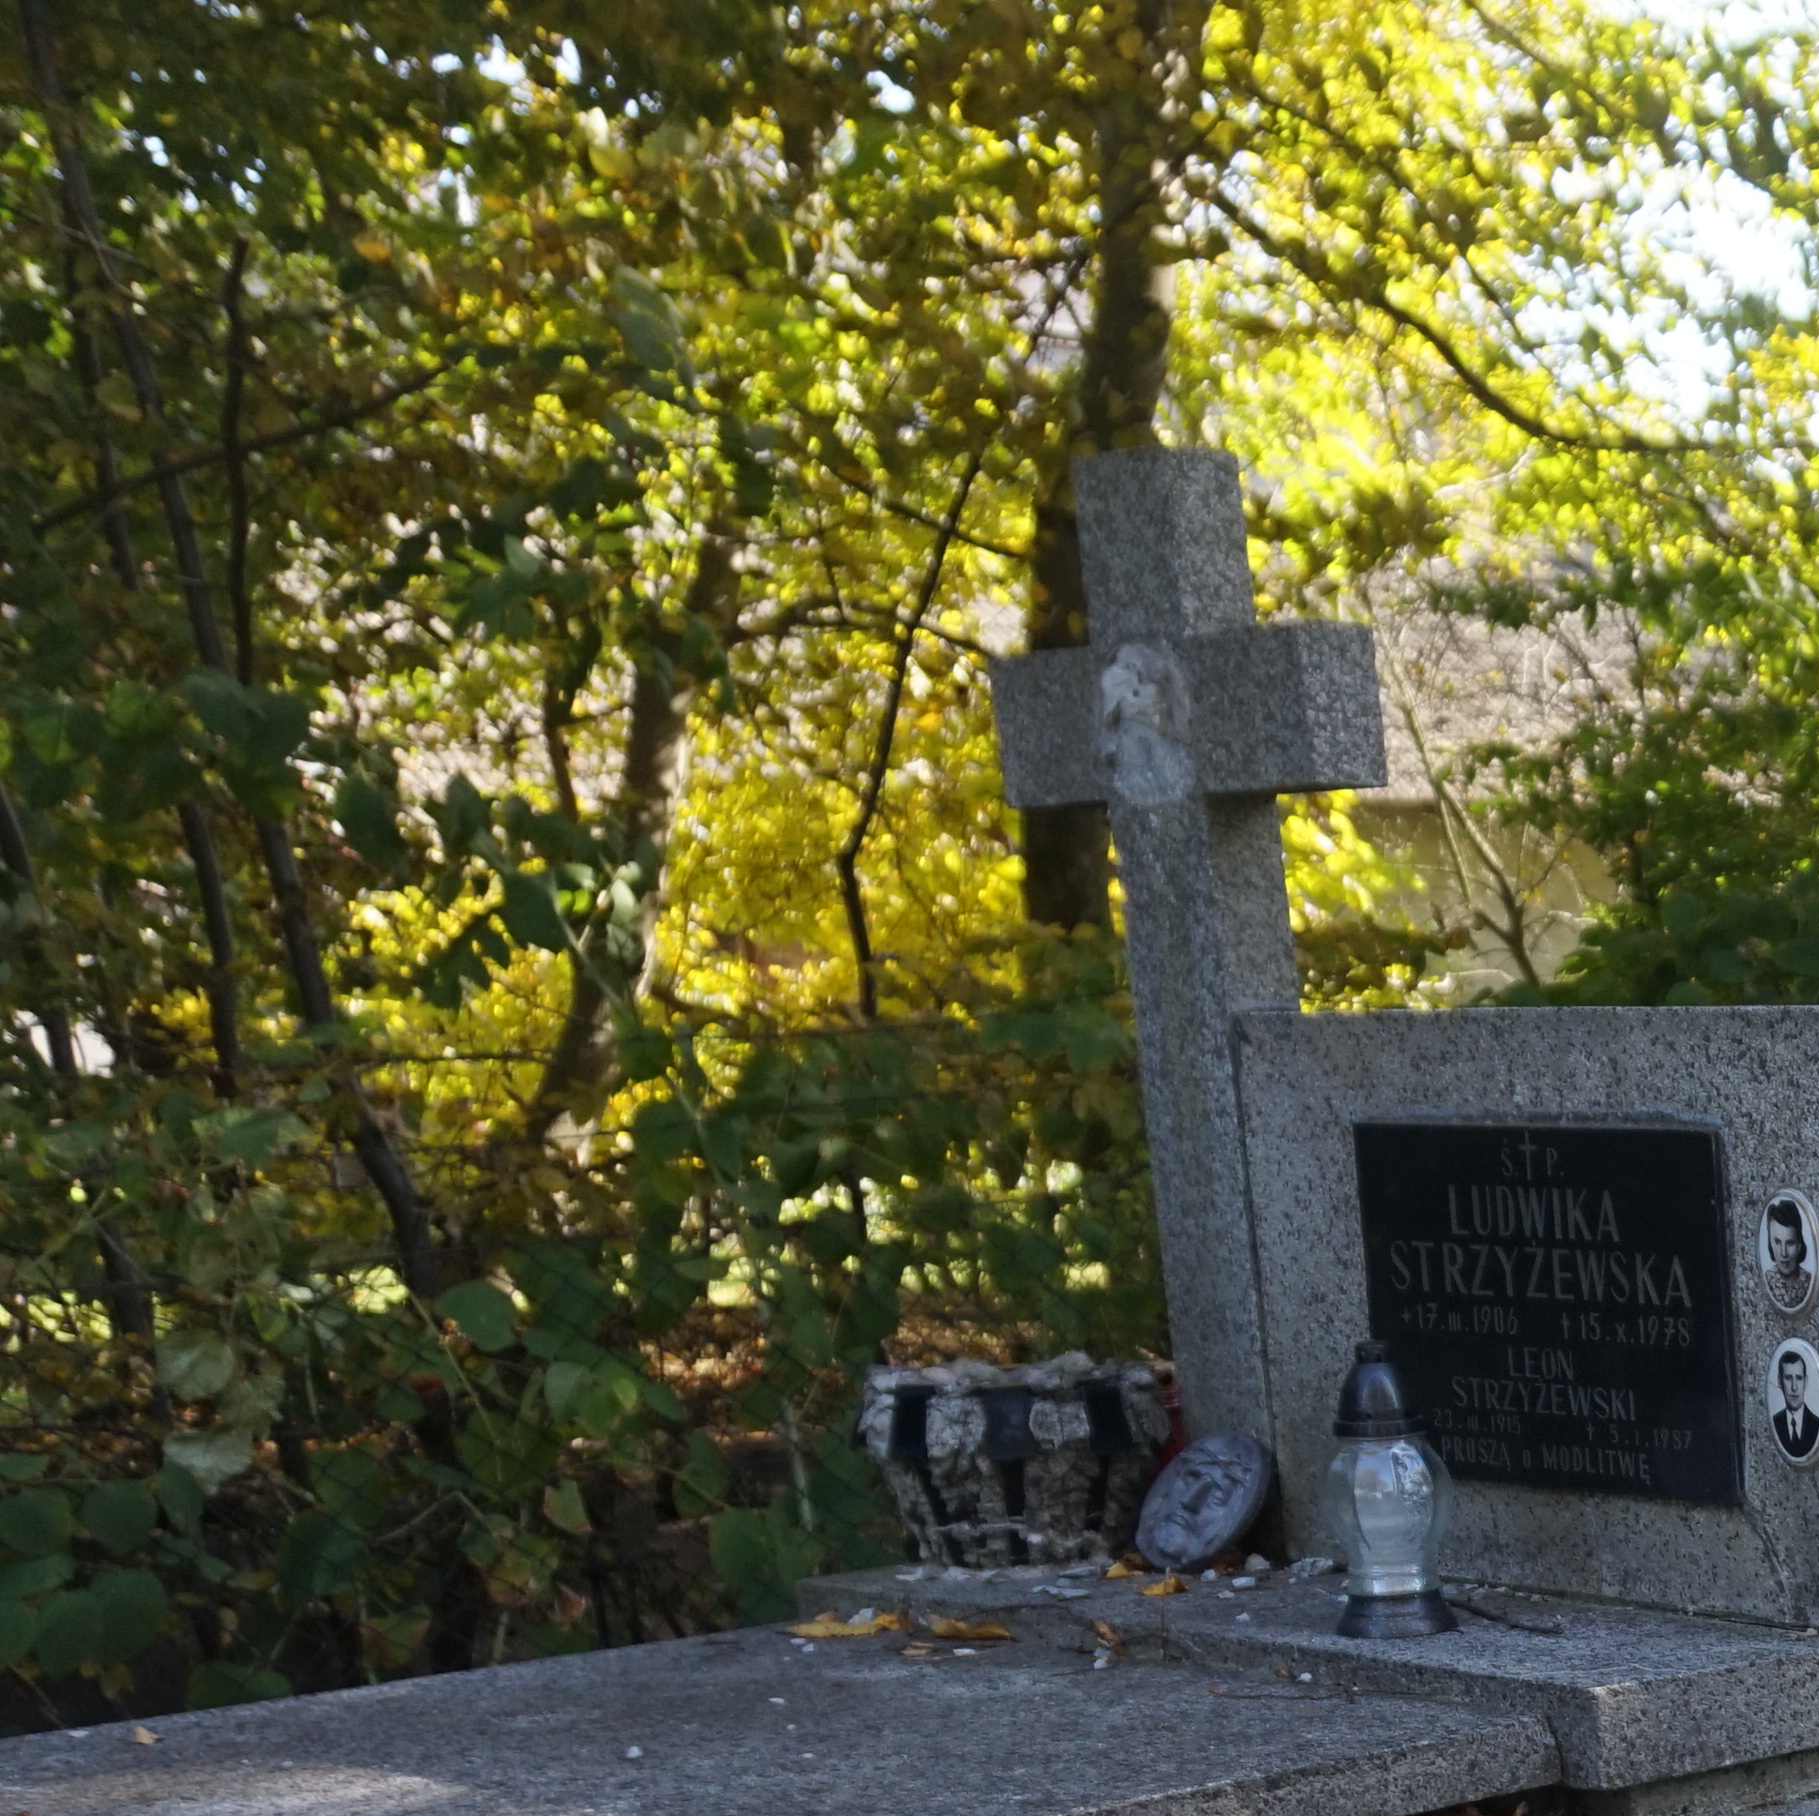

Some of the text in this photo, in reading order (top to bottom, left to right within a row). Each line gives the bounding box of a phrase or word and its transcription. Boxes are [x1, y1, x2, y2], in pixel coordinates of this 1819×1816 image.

[1448, 1185, 1620, 1243] LUDWIKA
[1390, 1240, 1692, 1309] STRZYŻEWSKA
[1507, 1347, 1574, 1381] LEON
[1452, 1375, 1636, 1420] STRZYŻEWSKI
[1441, 1436, 1511, 1471] PROSZĄ
[1542, 1445, 1651, 1484] MODLITWĘ
